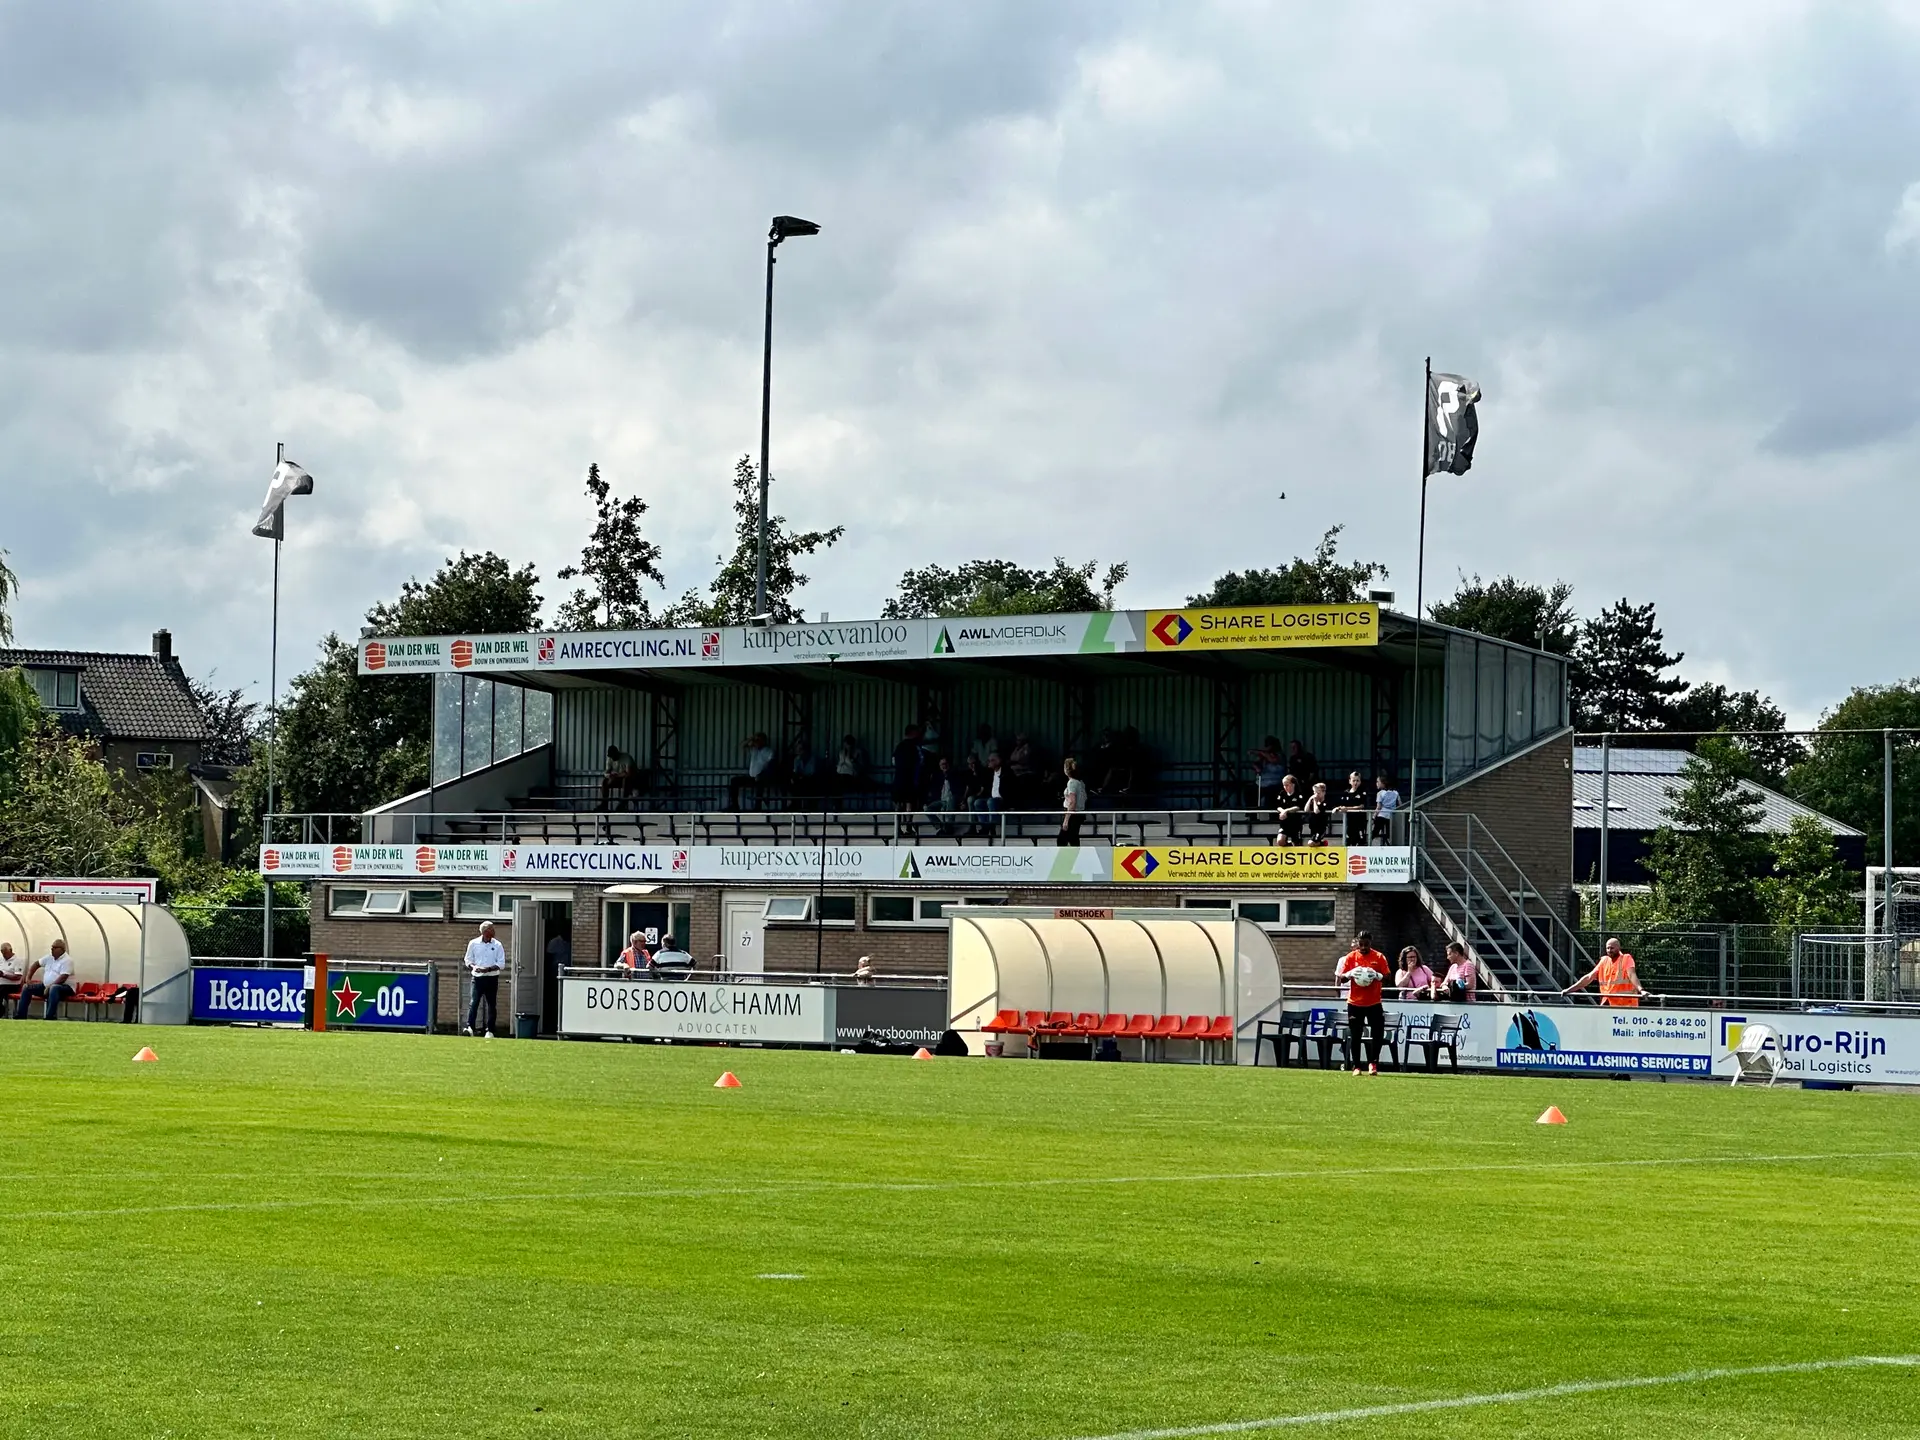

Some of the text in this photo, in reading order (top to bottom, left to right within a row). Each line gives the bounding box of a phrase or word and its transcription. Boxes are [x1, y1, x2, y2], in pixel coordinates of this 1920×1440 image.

[1200, 612, 1371, 630] SHARE LOGISTICS
[959, 625, 1066, 640] AWLMOERDIJK
[1200, 636, 1229, 644] Verwacht
[1295, 633, 1332, 643] wereldwijde
[1333, 632, 1353, 640] vracht
[388, 643, 440, 656] VAN DER WEL
[475, 640, 529, 653] VAN DER WEL
[560, 639, 696, 659] AMRECYCLING.NL
[959, 640, 1015, 648] WAREHOUSING
[489, 657, 495, 665] EN
[281, 852, 320, 860] VAN DER WEL
[355, 849, 403, 859] VAN DER WEL
[439, 850, 488, 860] VAN DER WEL
[1168, 850, 1340, 865] SHARE LOGISTICS
[526, 853, 662, 870] AMRECYCLING.NL
[925, 856, 1034, 867] AWLMOERDIJK
[1369, 857, 1383, 865] VAN
[1385, 857, 1399, 866] DER
[1168, 870, 1197, 878] Verwacht
[1217, 870, 1225, 878] als
[1227, 870, 1237, 878] het
[1263, 870, 1300, 879] wereldwijde
[1302, 870, 1322, 878] vracht
[1059, 910, 1105, 918] SMITSHOEK
[741, 936, 752, 946] 27
[209, 979, 306, 1012] Heineke
[1461, 1012, 1471, 1029] &
[1612, 1016, 1629, 1025] Tel.
[1632, 1017, 1648, 1025] 010
[1657, 1017, 1663, 1025] 4
[1665, 1017, 1678, 1026] 28
[1680, 1018, 1692, 1026] 42
[1694, 1018, 1707, 1027] 00
[677, 1022, 757, 1035] ADVOCATEN
[1612, 1028, 1706, 1040] Mail: info@lashing.nl
[1500, 1052, 1708, 1071] INTERNATIONAL LASHING SERVICE BV
[1771, 1056, 1872, 1074] lobal Logistics
